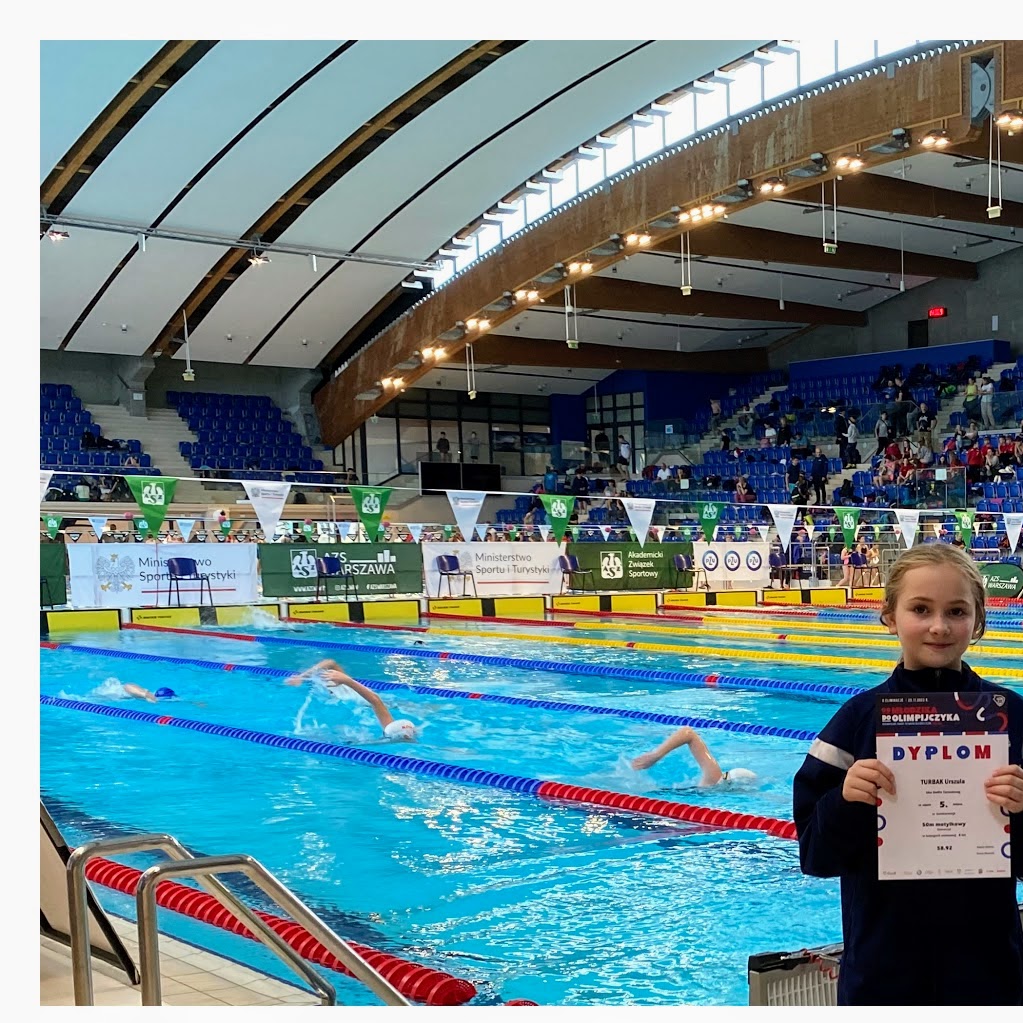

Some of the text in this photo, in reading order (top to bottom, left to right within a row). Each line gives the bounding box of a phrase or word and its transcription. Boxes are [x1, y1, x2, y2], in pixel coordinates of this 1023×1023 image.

[475, 552, 532, 563] Ministerstwo
[627, 550, 664, 559] Akademicki
[138, 557, 212, 568] Miniswo
[628, 560, 654, 570] Związek
[337, 563, 396, 576] ARSZAWA
[475, 564, 506, 576] Sportu
[511, 564, 550, 576] Turystyki
[628, 569, 659, 579] Sportowy
[891, 713, 960, 722] OLIMPIJCZYKA
[892, 744, 991, 761] DYPLOM
[939, 800, 948, 808] 5.
